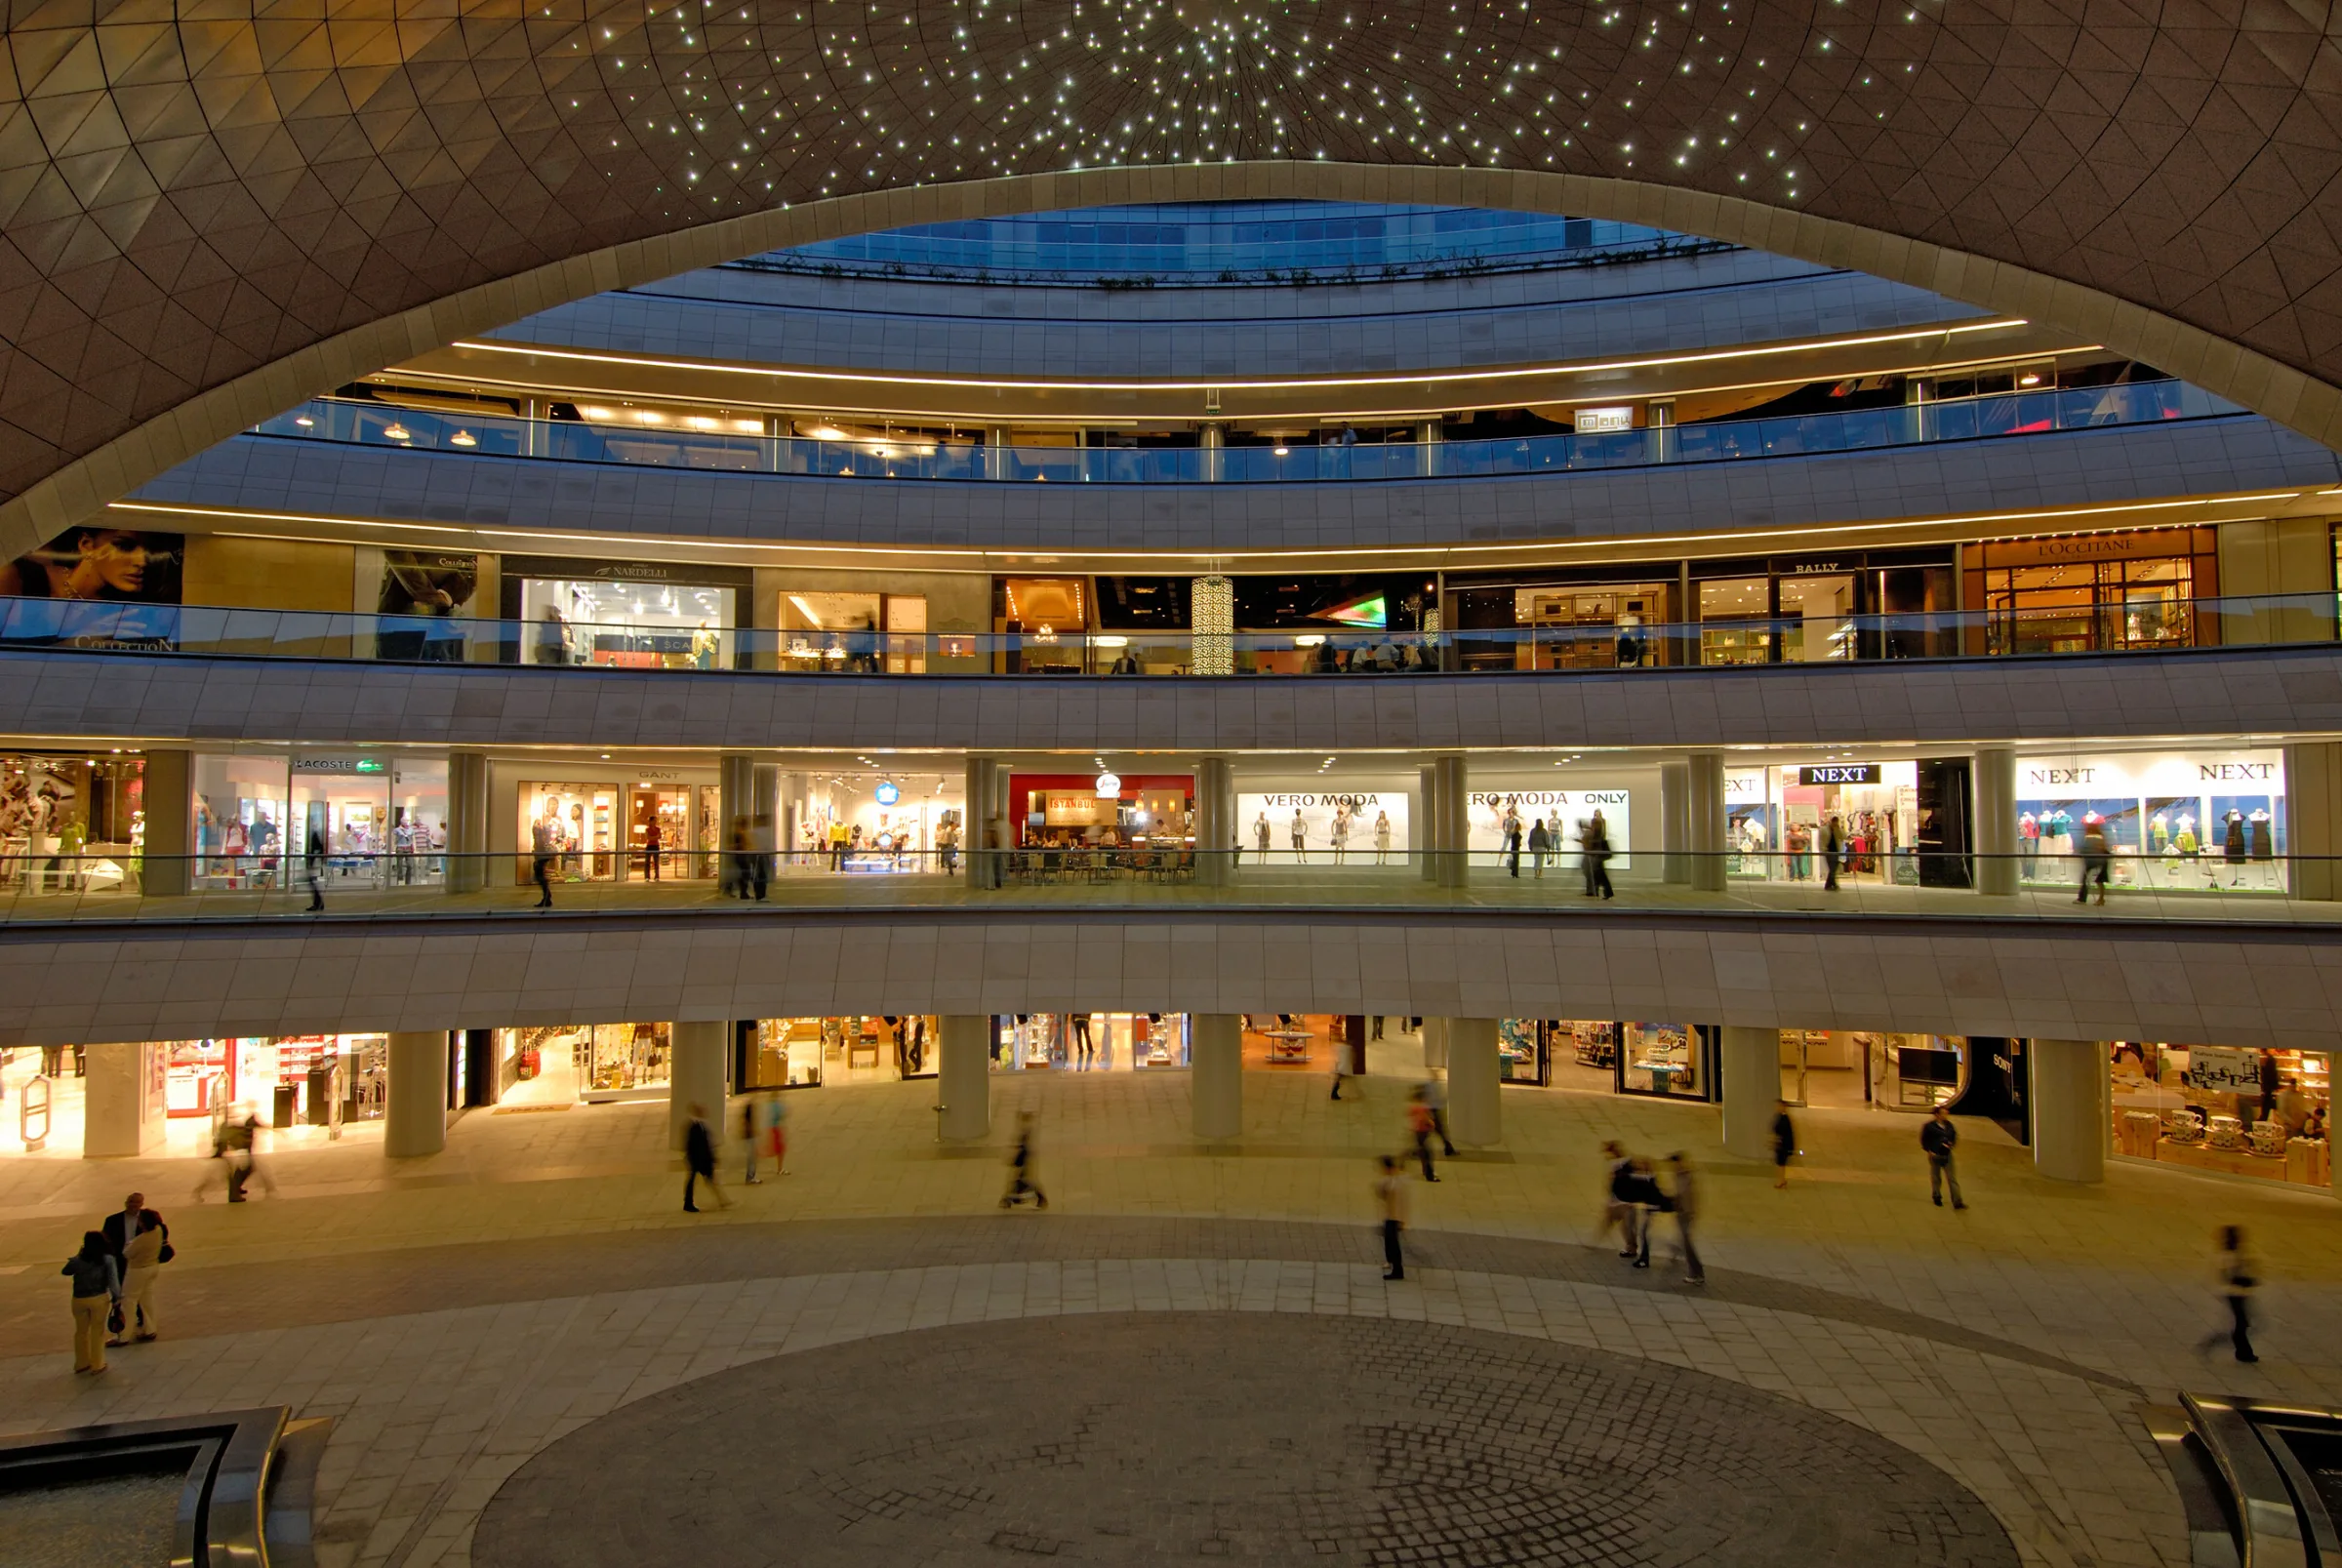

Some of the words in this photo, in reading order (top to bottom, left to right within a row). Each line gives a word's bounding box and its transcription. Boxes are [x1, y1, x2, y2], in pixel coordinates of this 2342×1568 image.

[2039, 540, 2134, 556] L'OCCITANE
[613, 567, 666, 578] NARDELLI
[1796, 563, 1838, 574] BALLY
[74, 634, 175, 652] COLLECTION
[296, 760, 351, 769] LACOSTE
[1812, 767, 1867, 783] NEXT
[2031, 768, 2095, 784] NEXT
[2200, 763, 2275, 781] NEXT
[1724, 779, 1756, 791] EXT
[1264, 794, 1315, 806] VERO
[1320, 794, 1379, 806] MODA
[1507, 792, 1568, 805] MODA
[1585, 793, 1627, 804] ONLY
[1994, 1054, 2011, 1073] SONY
